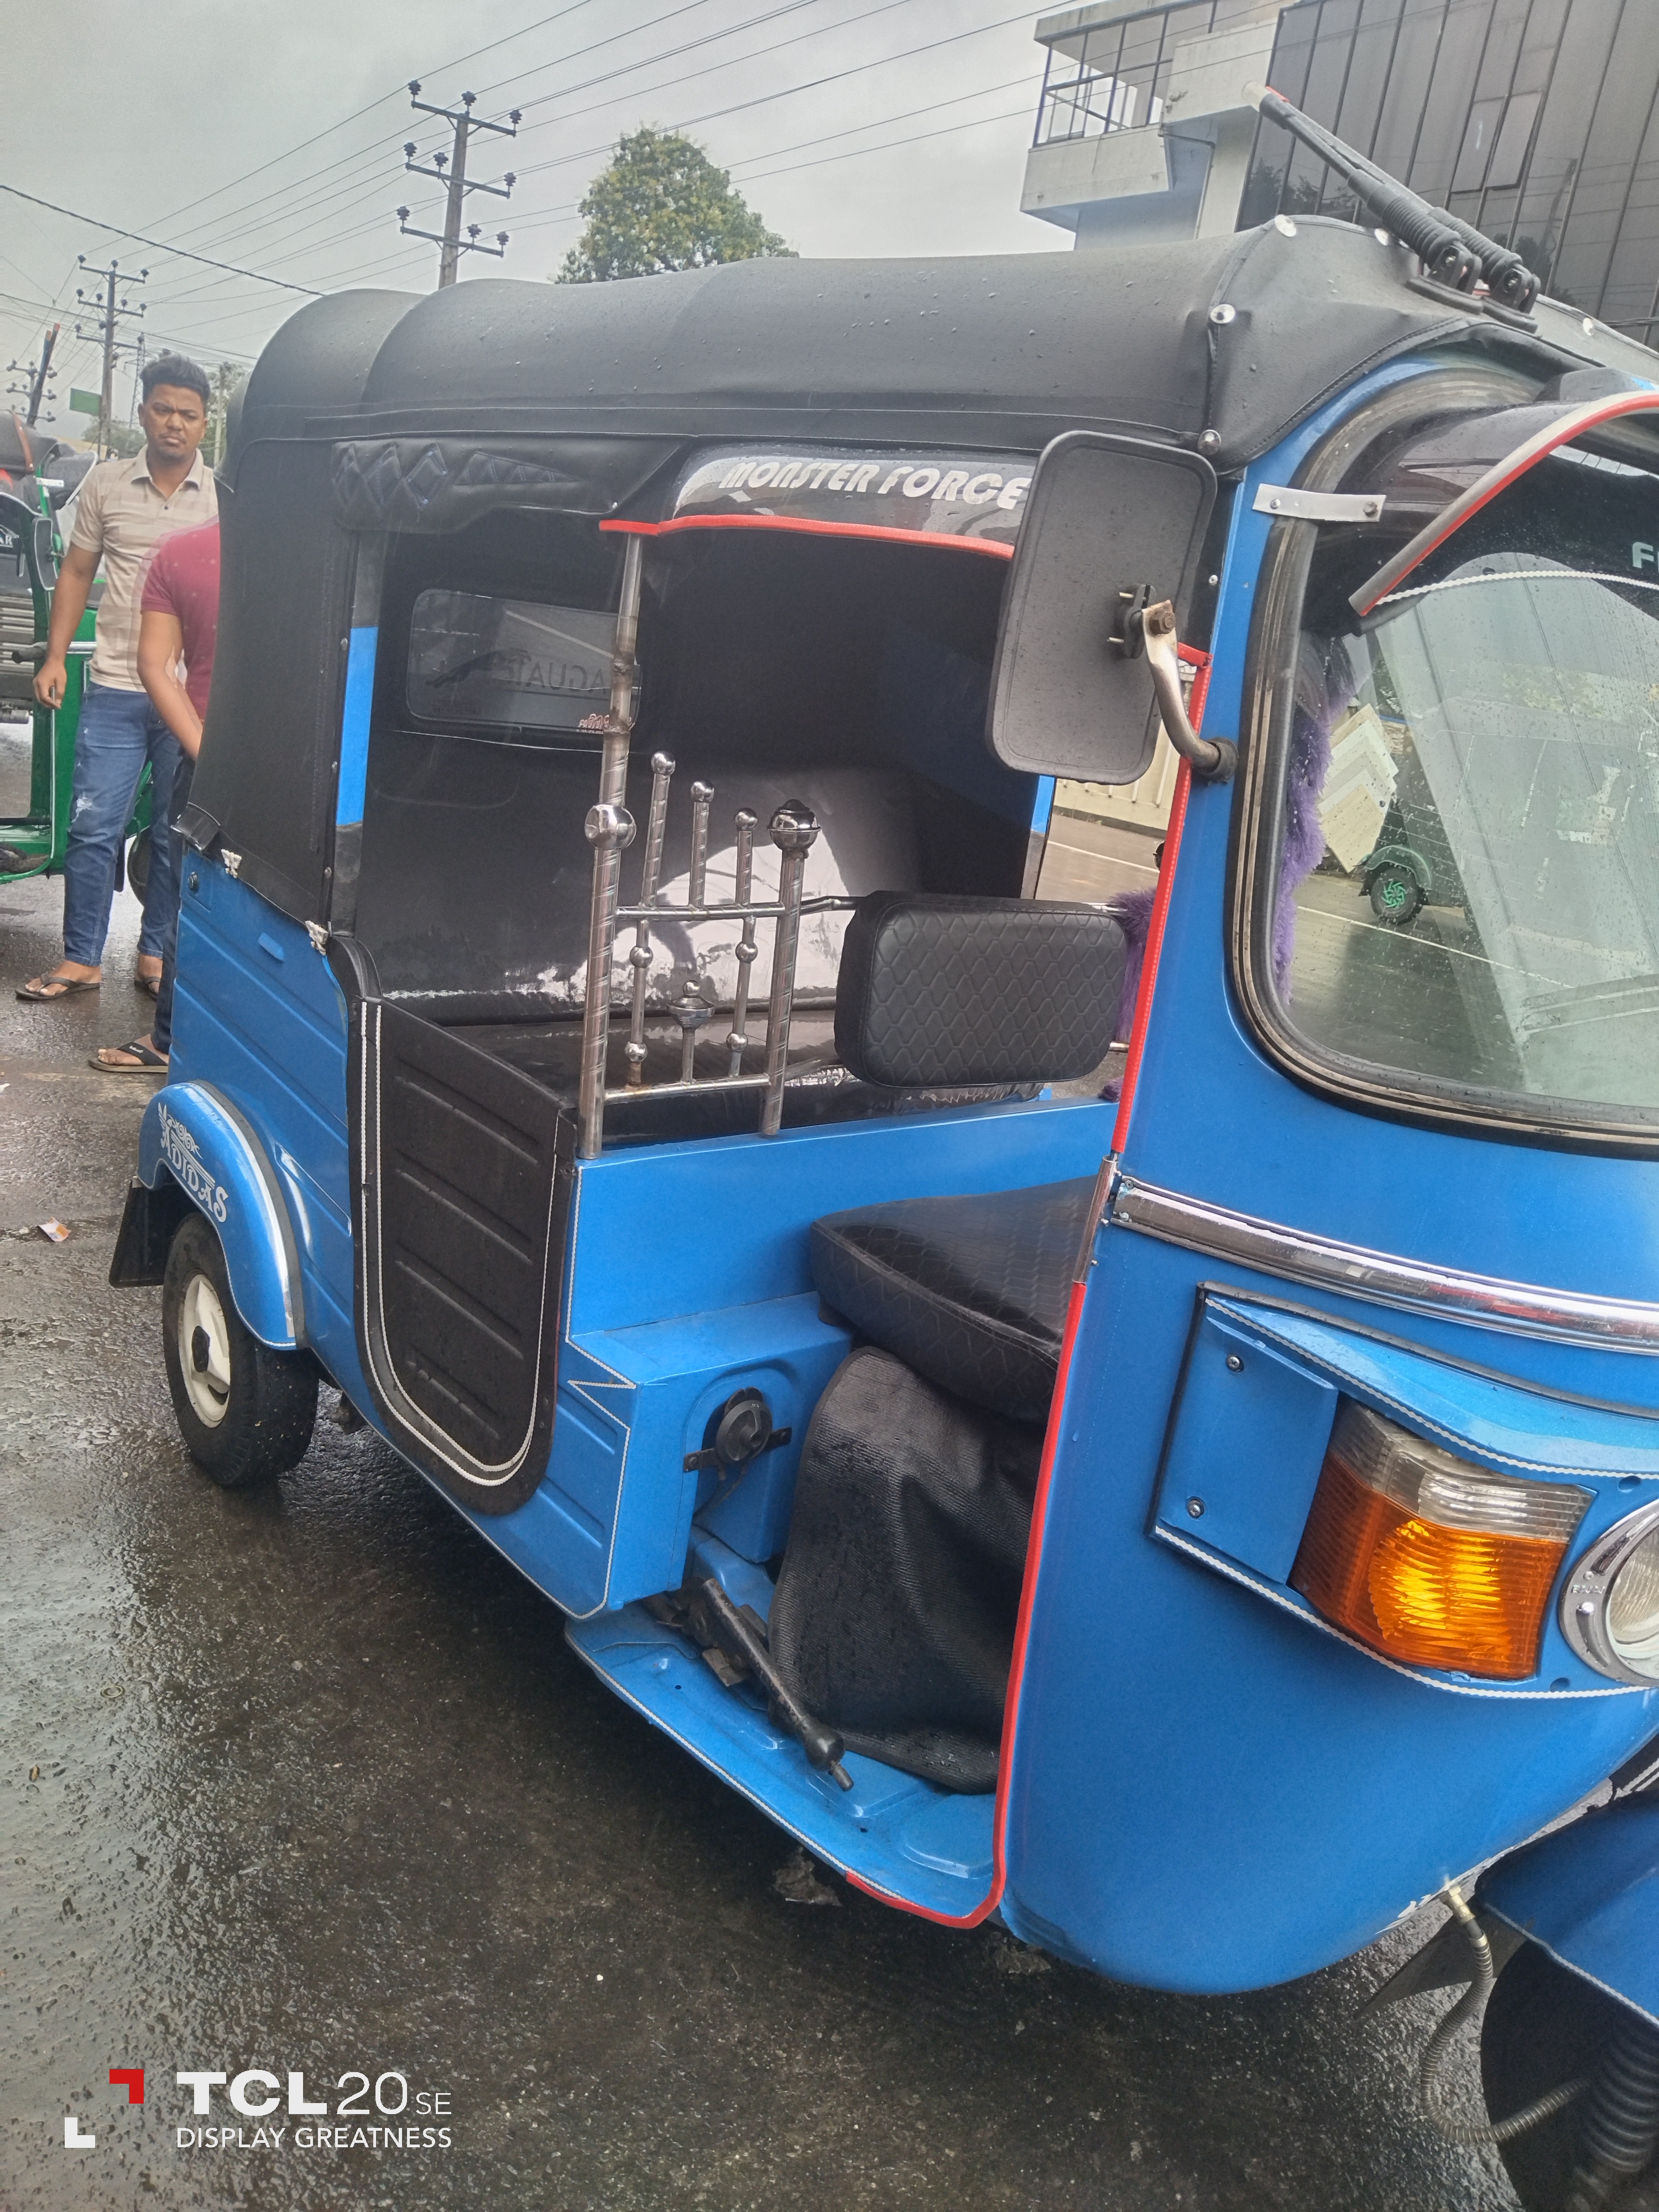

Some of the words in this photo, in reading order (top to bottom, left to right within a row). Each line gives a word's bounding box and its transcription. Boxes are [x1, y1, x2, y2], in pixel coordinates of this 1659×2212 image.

[718, 462, 881, 492] MONSTER
[877, 466, 1032, 510] FORCE
[1632, 541, 1659, 574] F
[160, 1125, 228, 1223] ADIDAS
